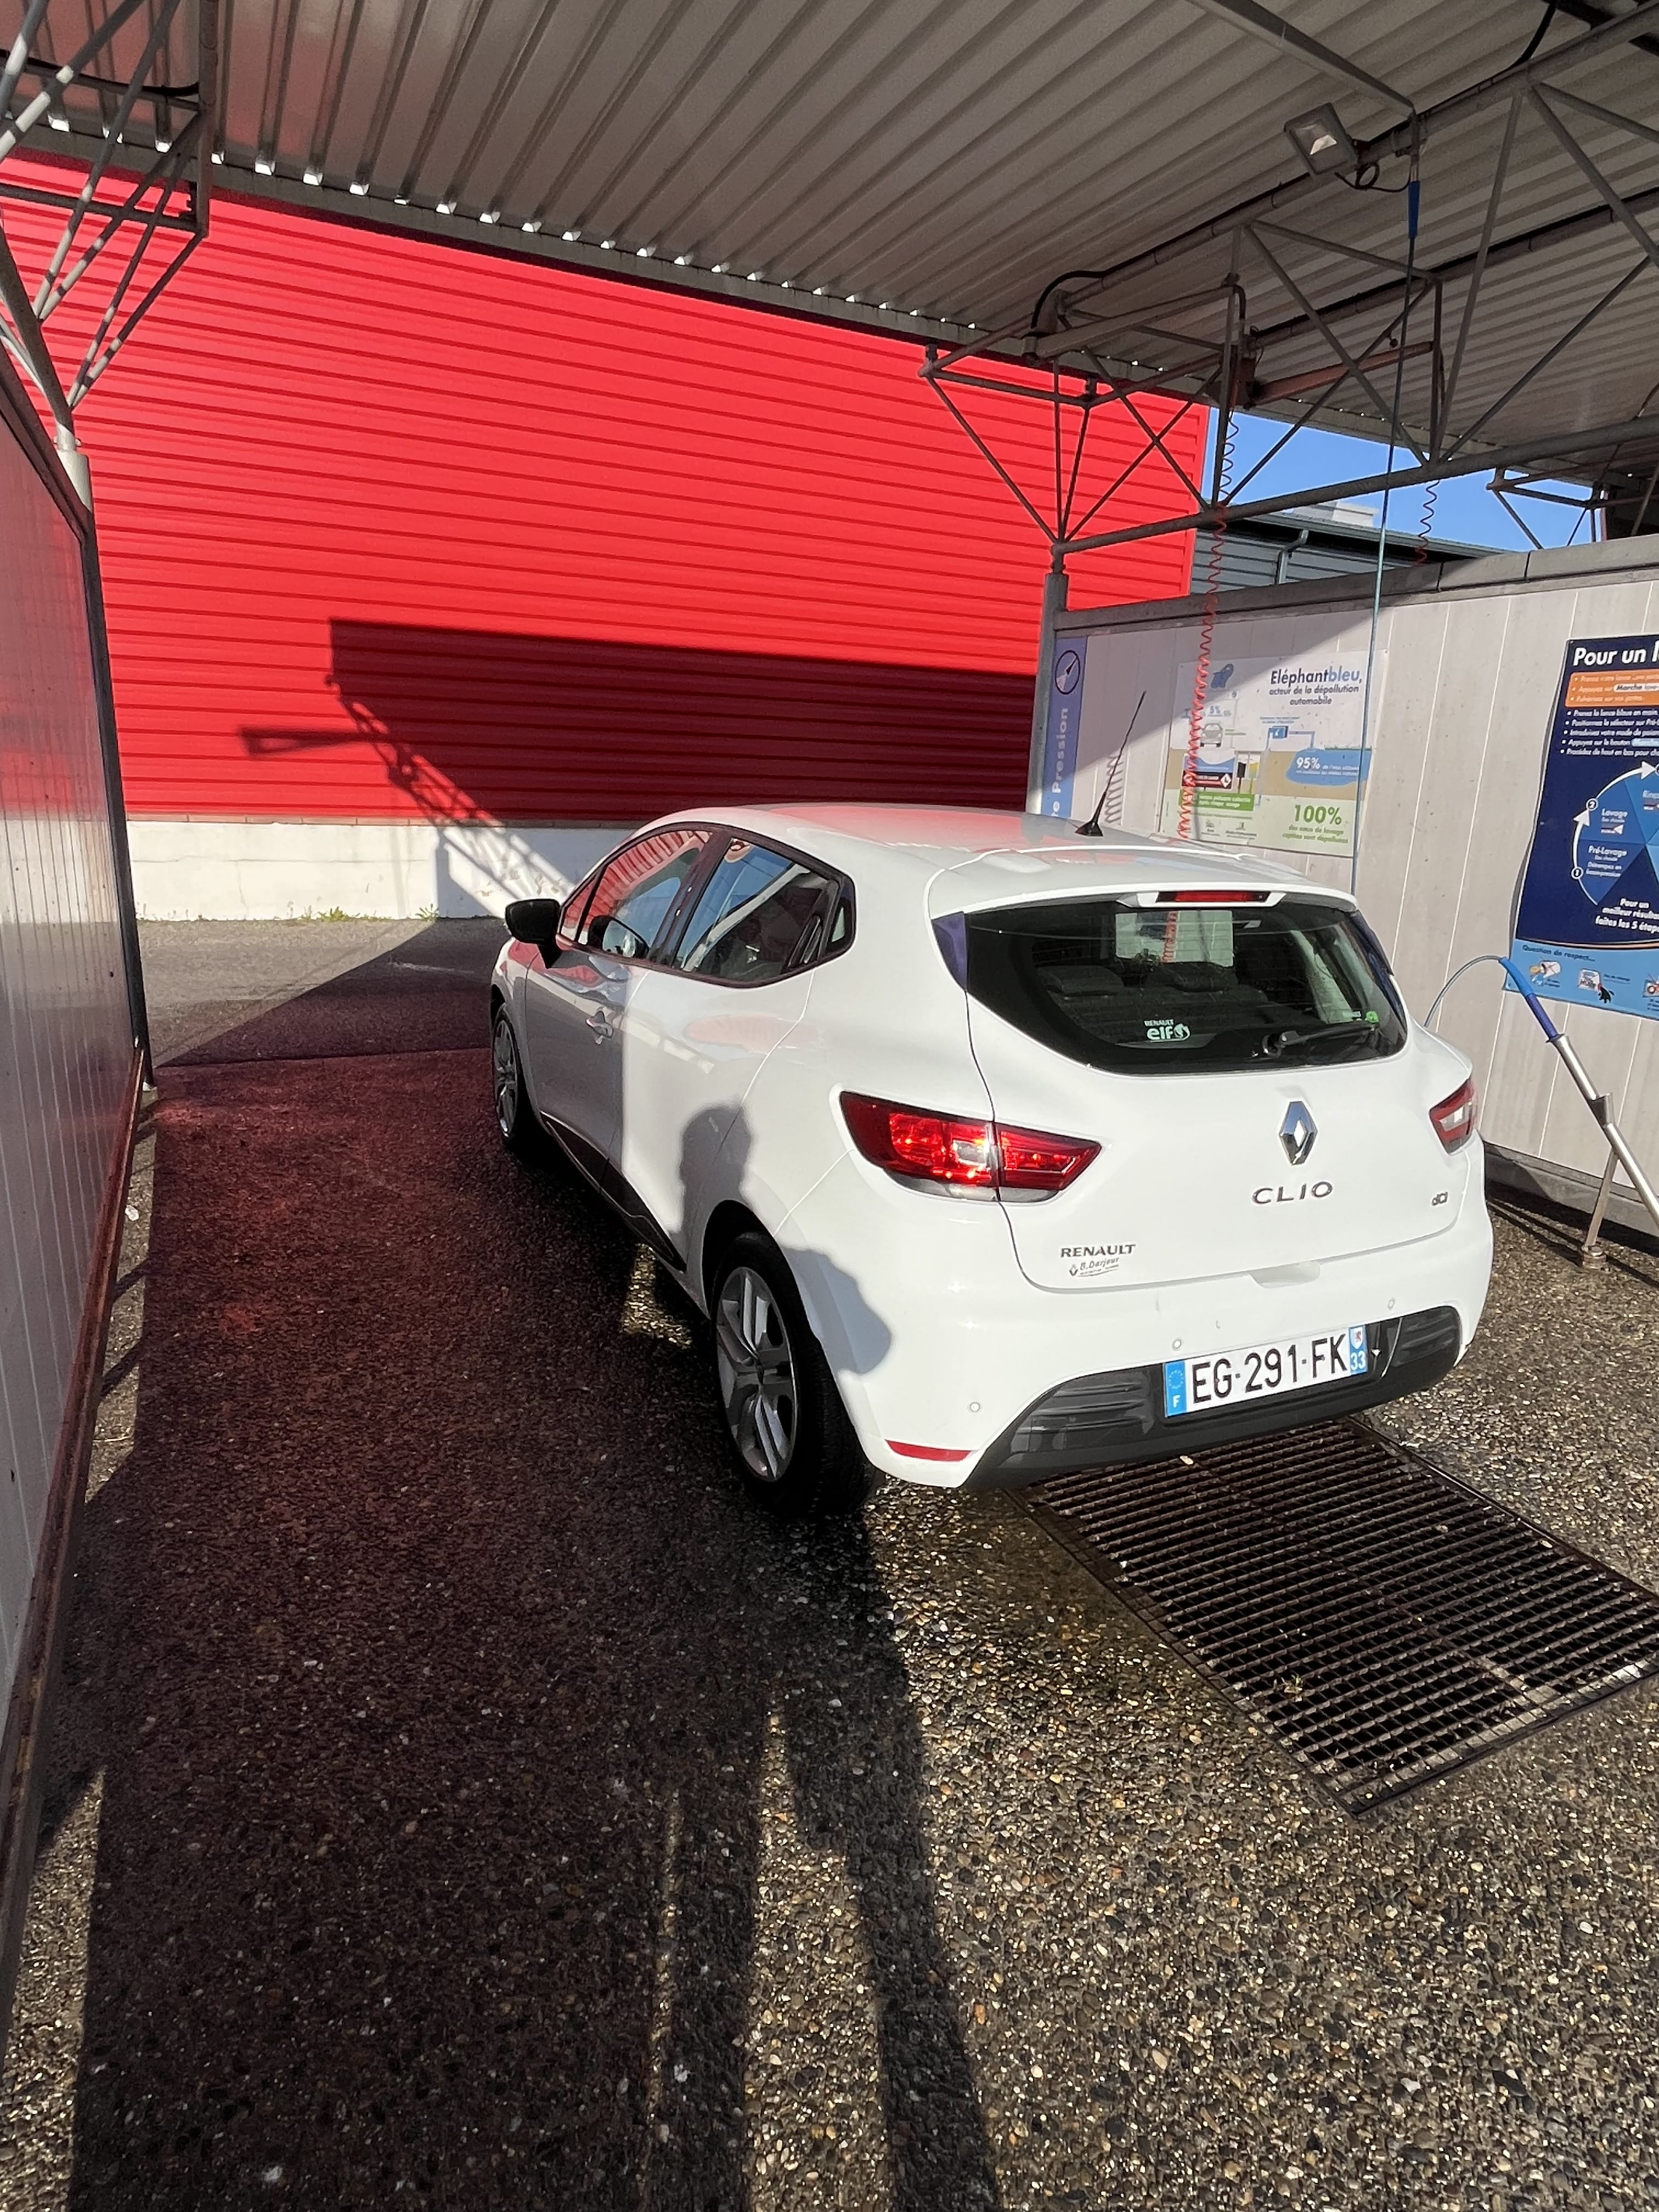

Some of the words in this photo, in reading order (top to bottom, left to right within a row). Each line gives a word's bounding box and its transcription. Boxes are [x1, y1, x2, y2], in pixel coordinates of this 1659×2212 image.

[1573, 647, 1618, 666] Pour
[1622, 649, 1646, 664] un
[1269, 687, 1291, 696] acteur
[1294, 685, 1304, 695] de
[1305, 686, 1312, 695] la
[1314, 684, 1359, 696] dépollution
[1289, 697, 1332, 706] automobile
[1052, 707, 1069, 794] Pression
[1296, 757, 1321, 769] 95%
[1295, 804, 1342, 825] 100%
[1601, 808, 1628, 818] Lavage
[1620, 898, 1638, 907] Pour
[1595, 916, 1617, 926] faites
[1618, 919, 1630, 928] les
[1631, 921, 1638, 929] 5
[1522, 944, 1552, 955] Question
[1147, 1026, 1173, 1040] elf
[1252, 1181, 1333, 1205] CLIO
[1060, 1243, 1136, 1258] RENAULT
[1172, 1395, 1180, 1408] F
[1192, 1333, 1348, 1404] EG-291-FK
[1350, 1351, 1366, 1371] 33
